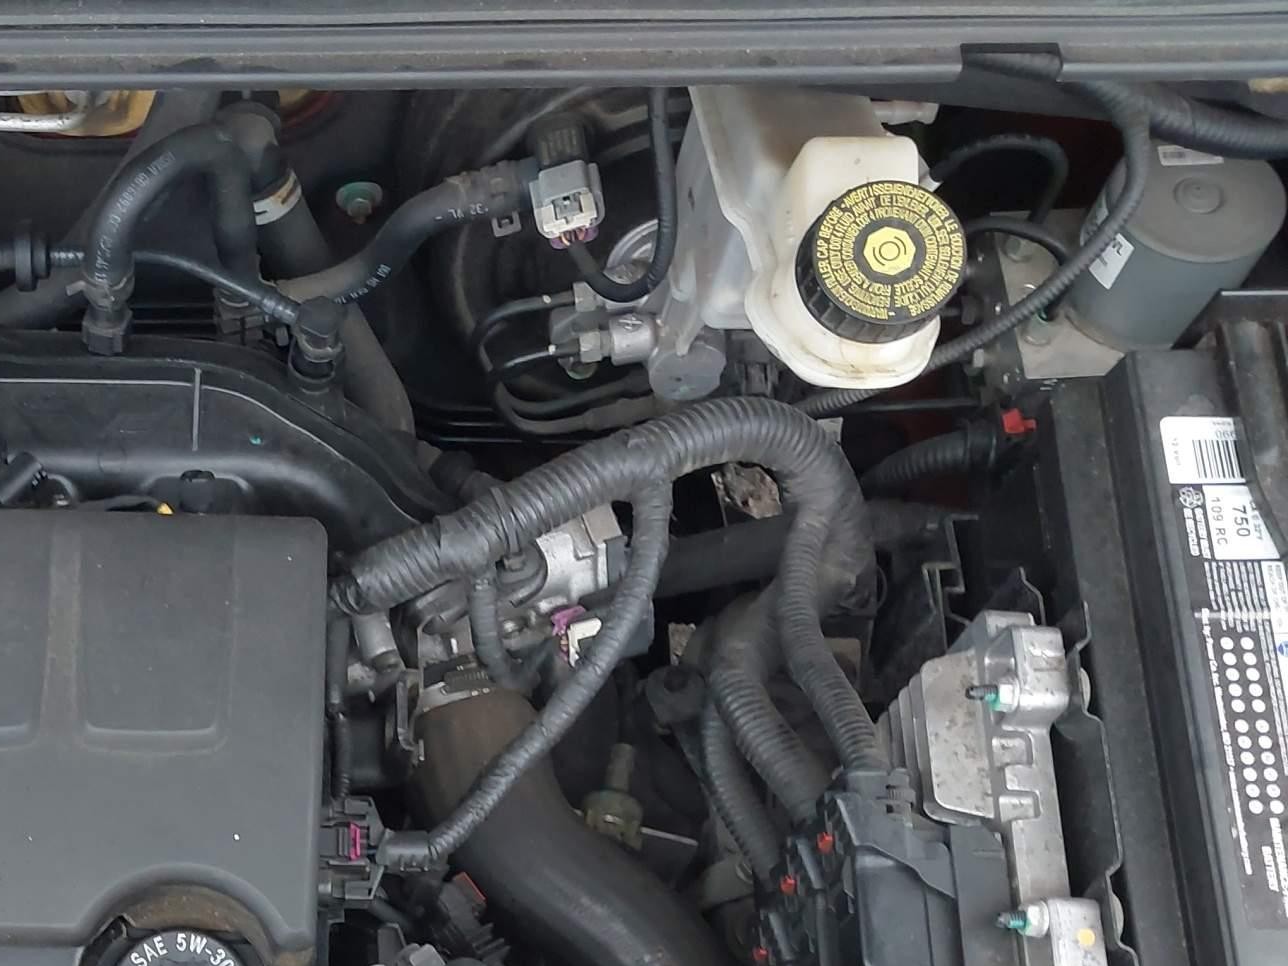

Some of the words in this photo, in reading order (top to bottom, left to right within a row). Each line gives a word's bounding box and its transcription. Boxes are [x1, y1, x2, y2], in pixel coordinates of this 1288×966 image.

[819, 206, 844, 238] BEFORE
[817, 238, 830, 258] CAP
[1211, 497, 1224, 523] 109
[1231, 505, 1251, 537] 750
